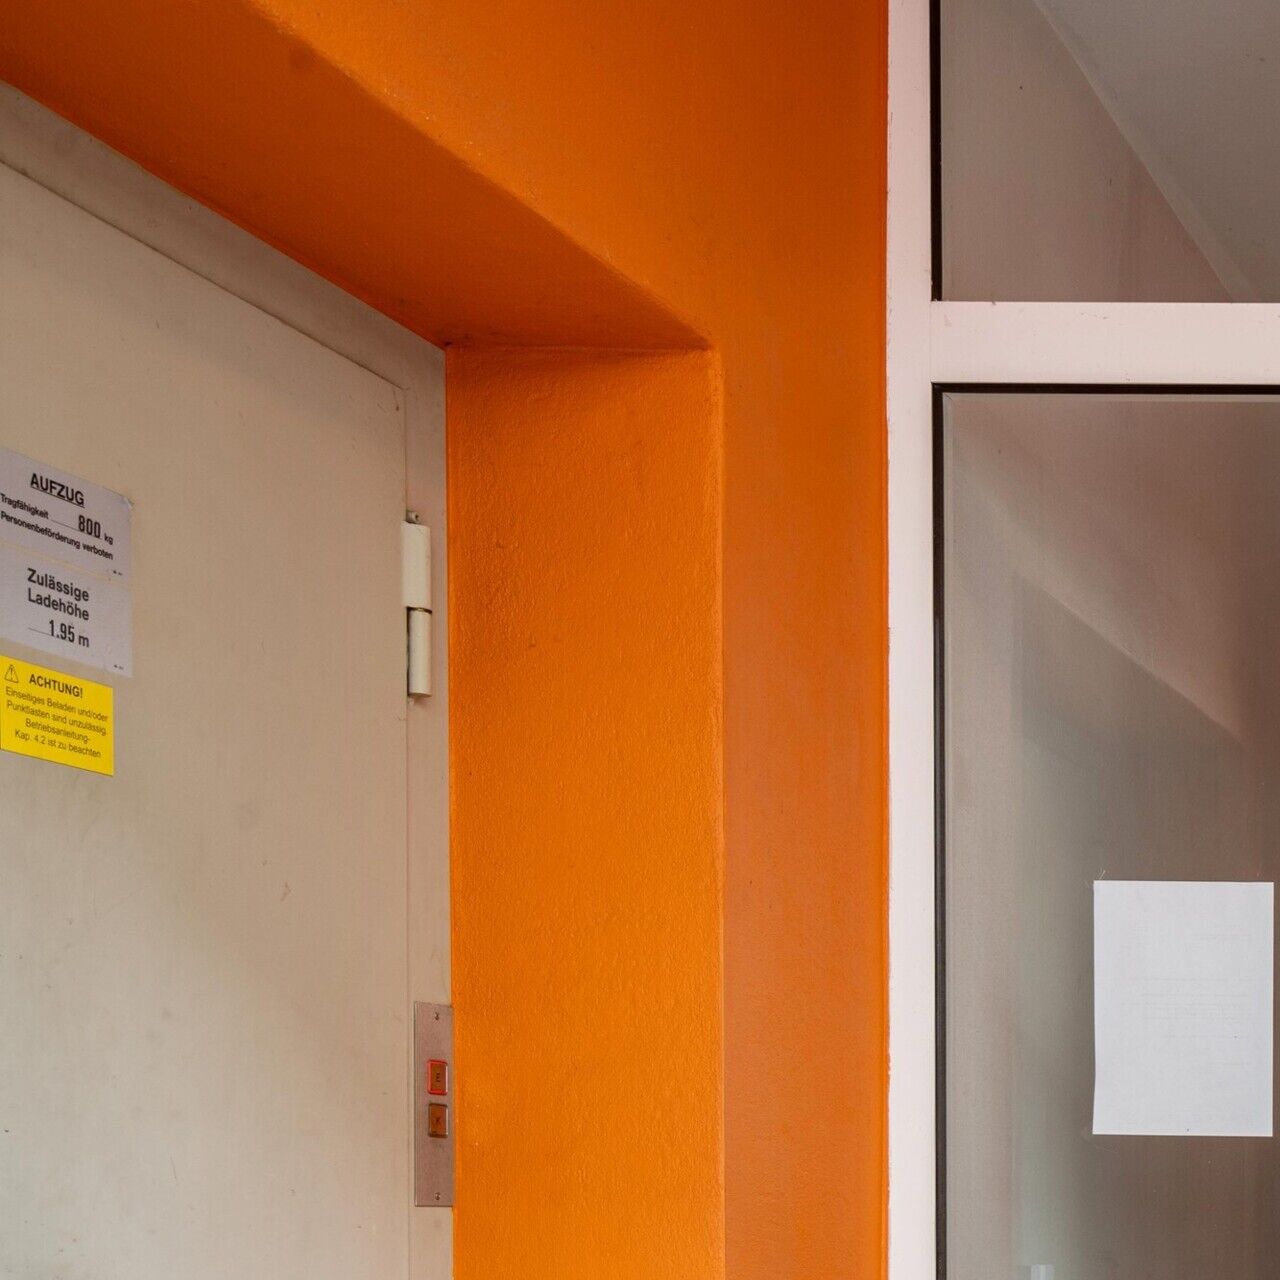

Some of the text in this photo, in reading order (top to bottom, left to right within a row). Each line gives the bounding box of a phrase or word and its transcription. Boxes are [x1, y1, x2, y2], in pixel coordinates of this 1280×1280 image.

[30, 472, 85, 508] AUFZUG
[0, 493, 114, 545] Tragfähigkeit 800 kg
[0, 511, 114, 560] Personenbeförderung verboten
[27, 567, 90, 602] Zulässige
[28, 587, 90, 621] Ladehöhe
[49, 619, 90, 649] 1.95 m
[5, 686, 45, 705] Einseitiges
[47, 697, 76, 713] Beladen
[29, 674, 83, 698] ACHTUNG!
[7, 699, 50, 719] Punktlasten
[52, 713, 67, 724] sind
[47, 738, 57, 747] ist
[58, 741, 67, 750] zu
